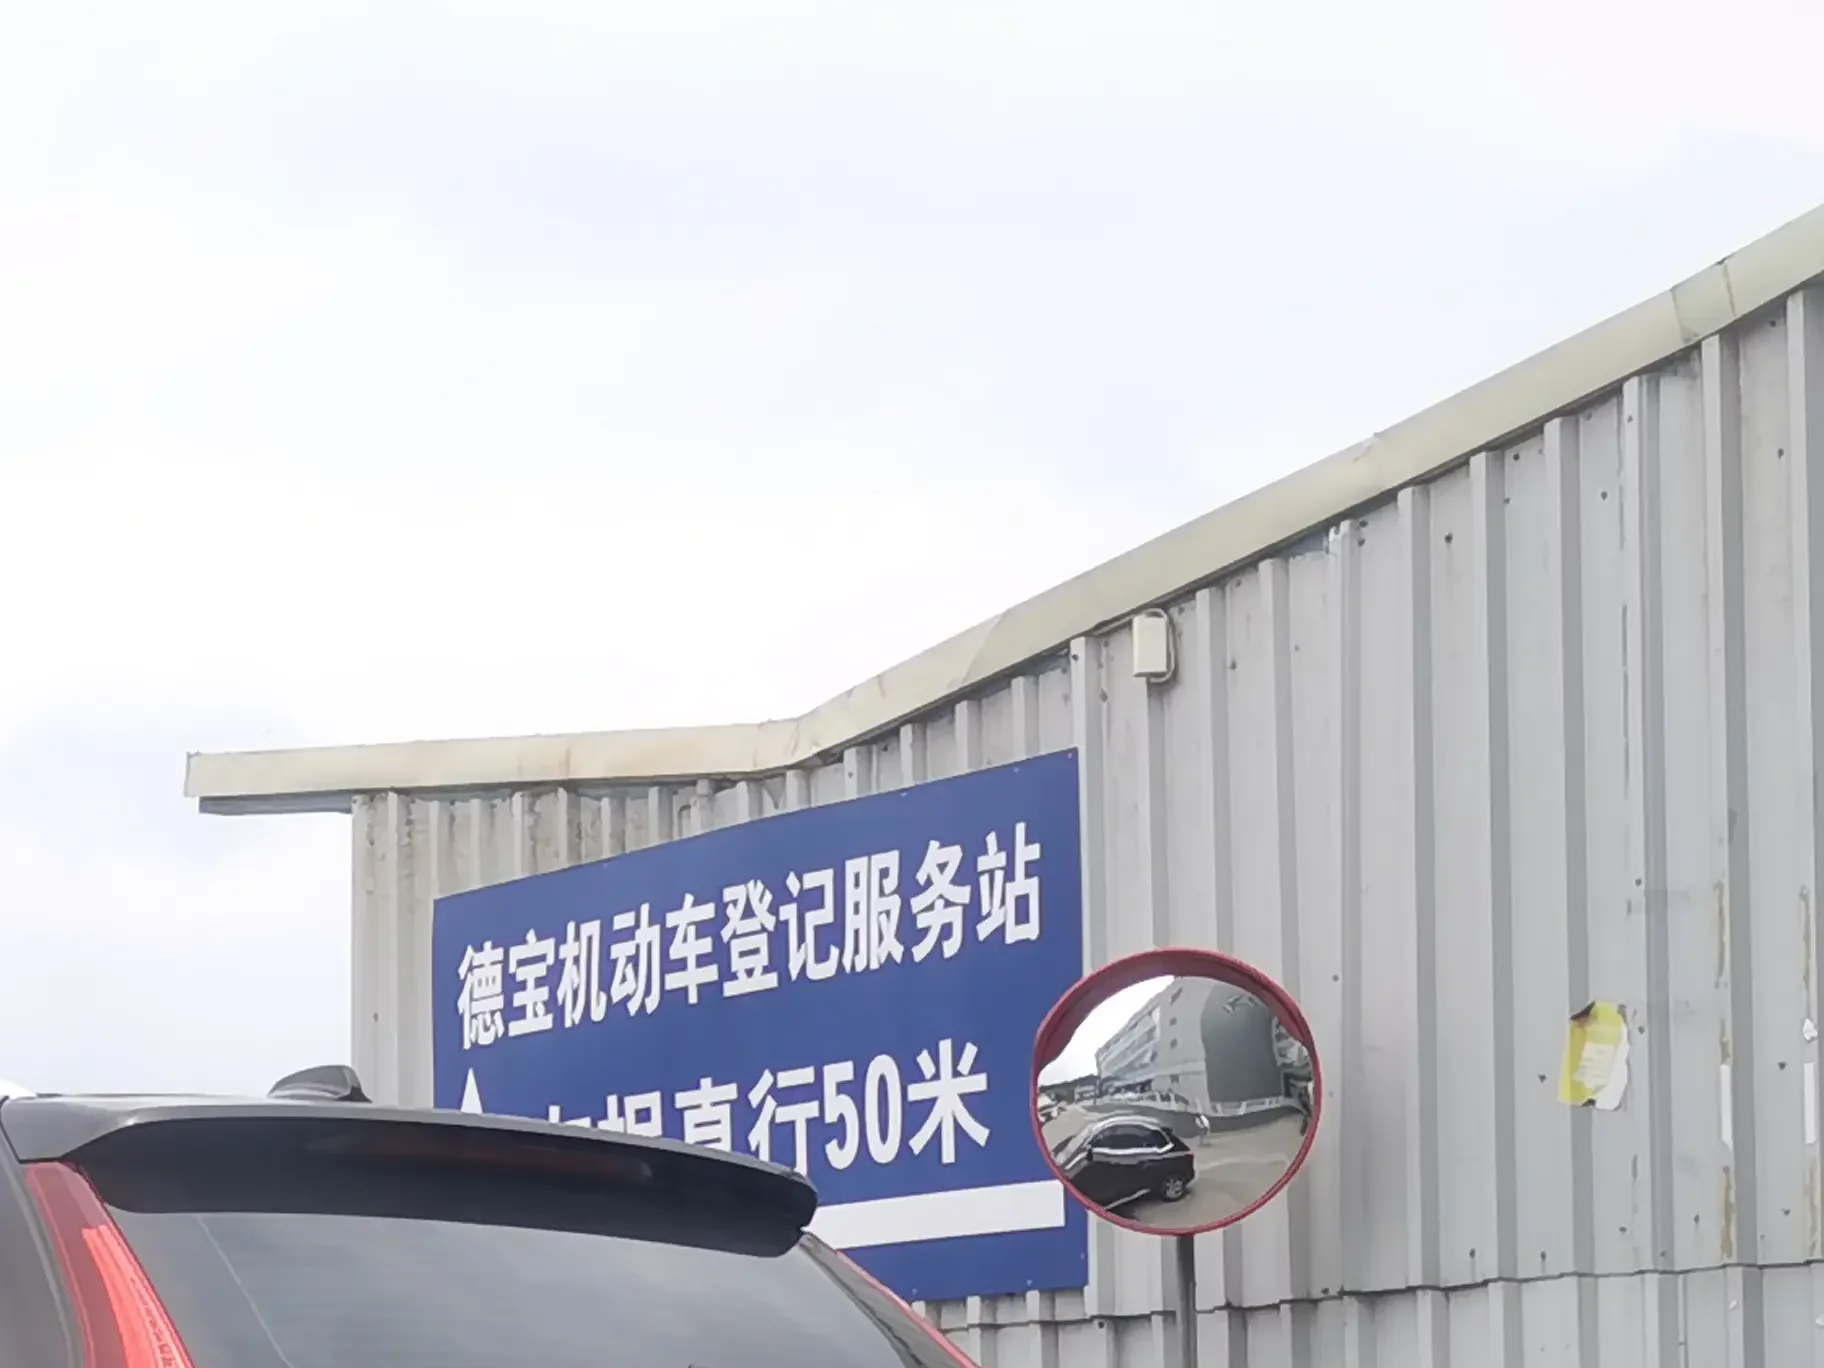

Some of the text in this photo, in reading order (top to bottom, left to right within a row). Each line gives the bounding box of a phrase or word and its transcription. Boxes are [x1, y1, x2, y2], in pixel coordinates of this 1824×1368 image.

[457, 822, 1041, 1050] 德宝机动车登记服务站
[546, 1038, 990, 1176] 直行50米
